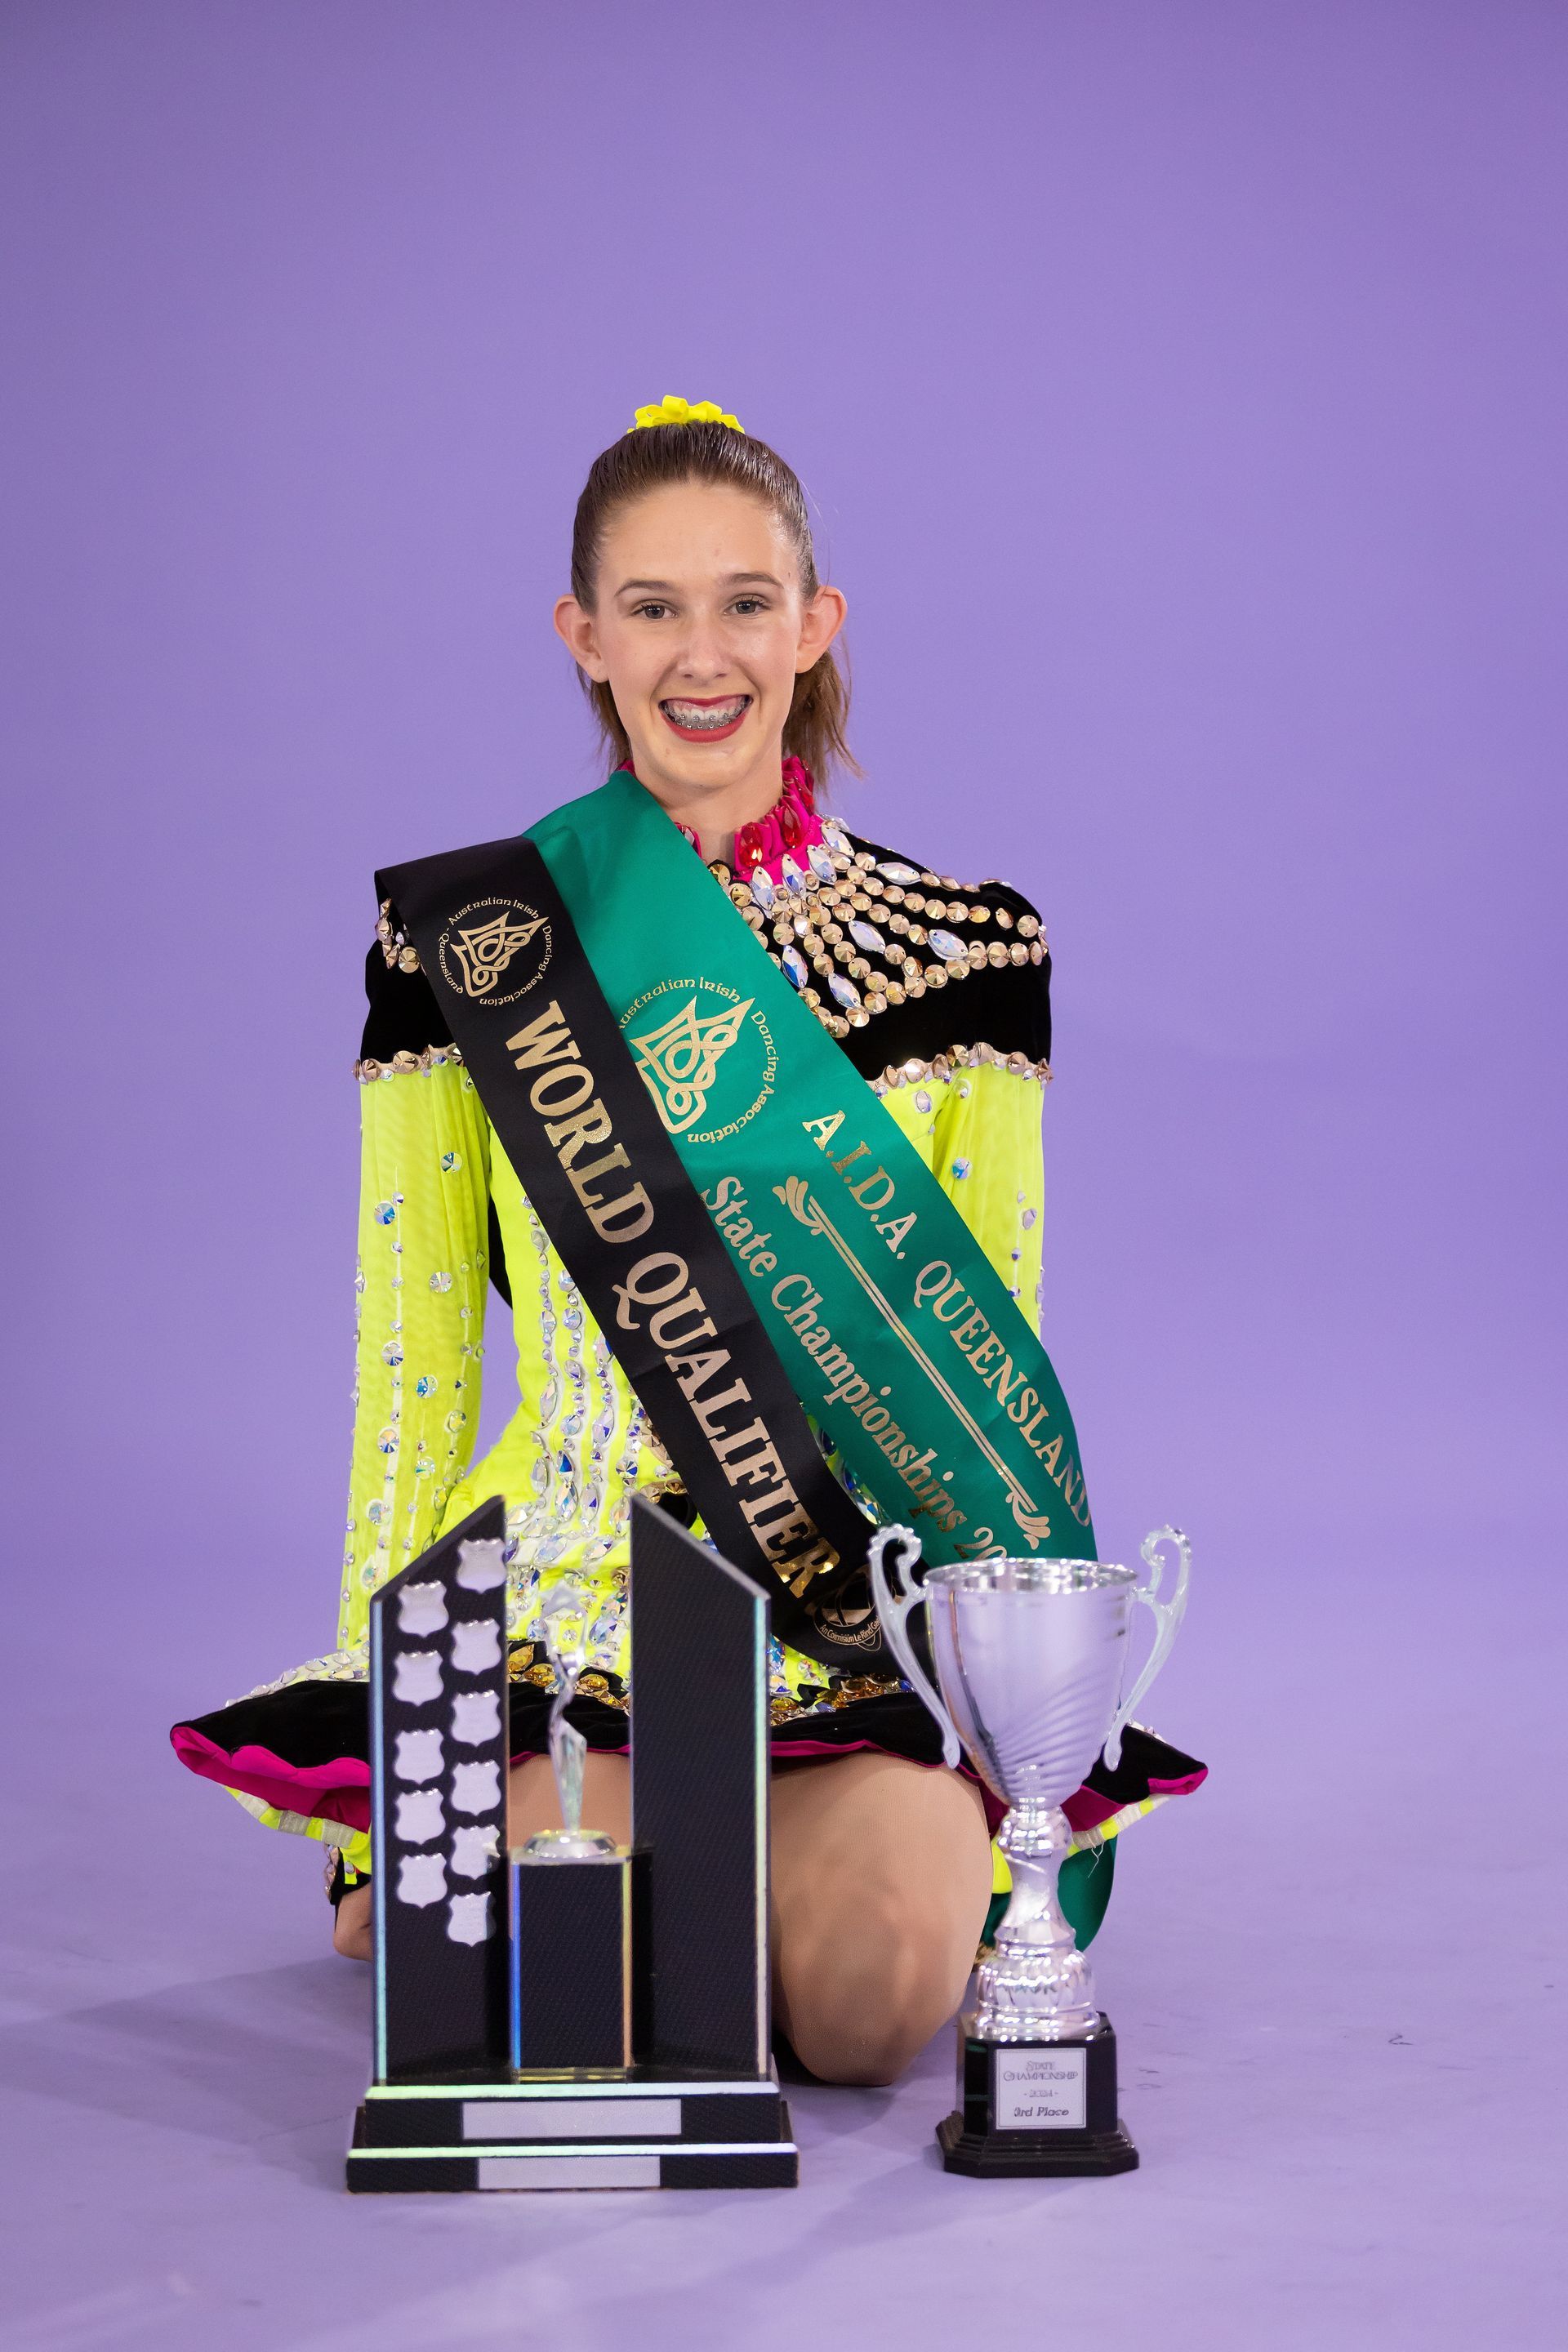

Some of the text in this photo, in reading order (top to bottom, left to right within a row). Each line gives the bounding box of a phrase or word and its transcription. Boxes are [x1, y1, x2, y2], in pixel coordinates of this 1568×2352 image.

[439, 897, 553, 1007] Australian Irish Dancing Association Queensland
[699, 976, 741, 1004] Irish
[751, 1010, 780, 1083] Dancing
[687, 1083, 775, 1143] Association
[506, 1000, 841, 1599] WORLD QUALIFIER
[802, 1110, 1091, 1527] A.I.D.A. QUEENSLAND
[701, 1176, 777, 1277] State
[771, 1273, 967, 1533] Championships
[1014, 2107, 1069, 2117] 3rd Place
